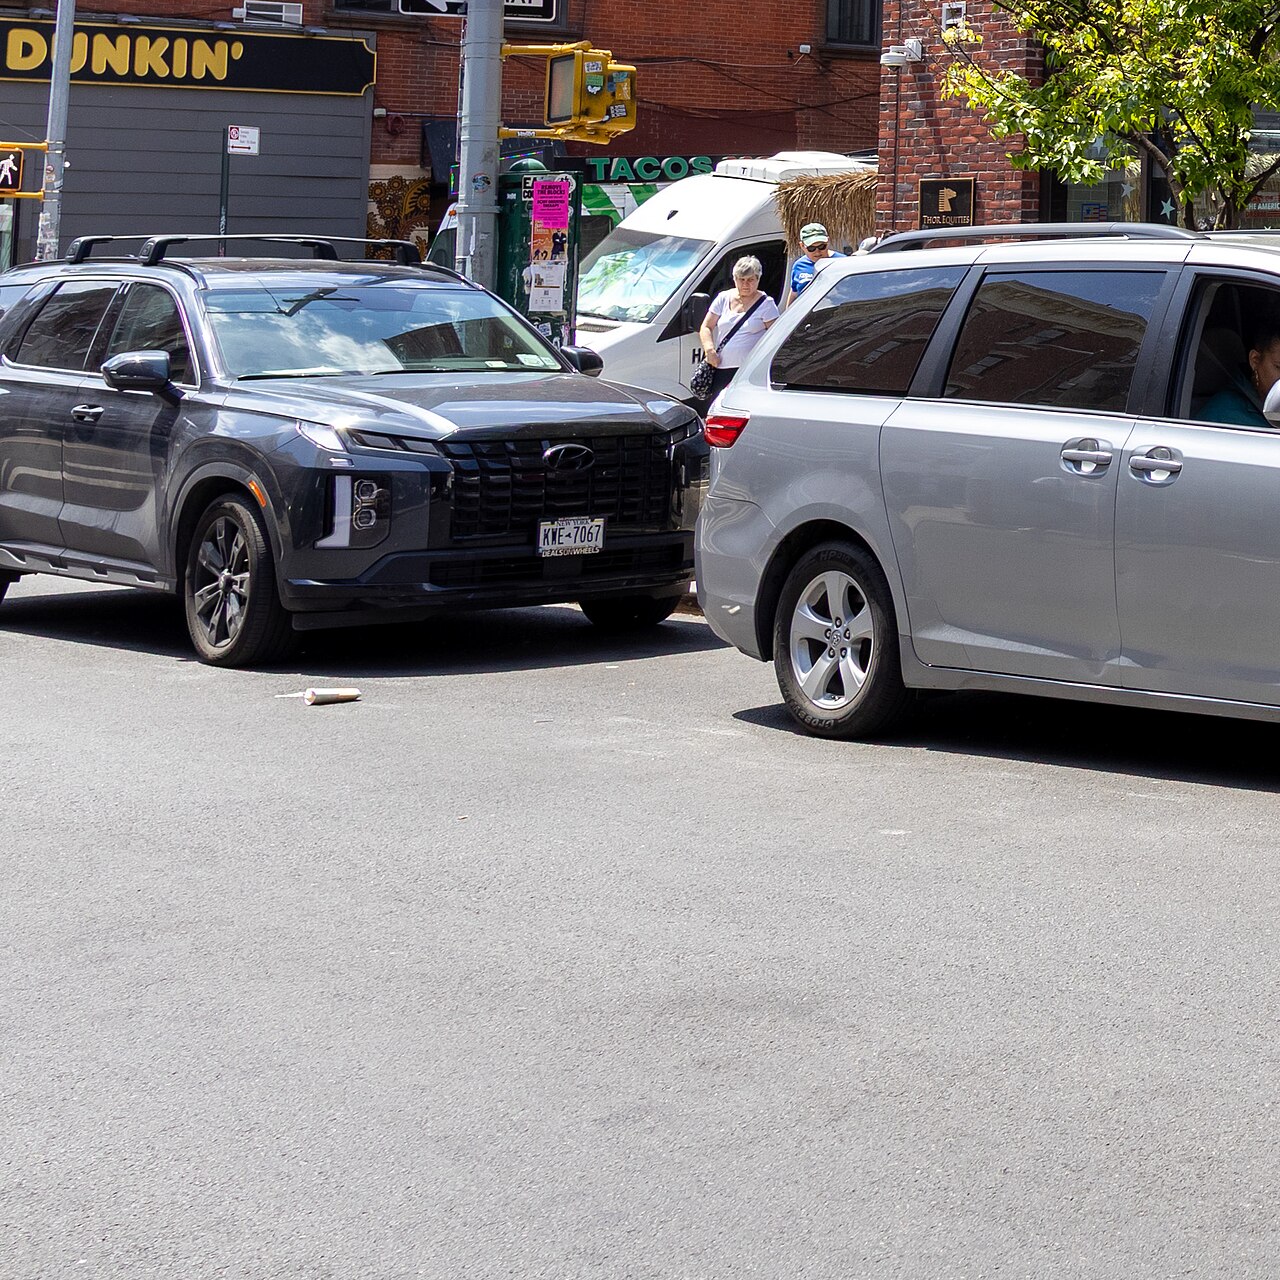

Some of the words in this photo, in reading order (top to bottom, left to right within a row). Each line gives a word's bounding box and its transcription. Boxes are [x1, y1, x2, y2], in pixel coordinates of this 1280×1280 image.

[586, 157, 715, 180] TACOS
[922, 215, 941, 224] THOR
[942, 215, 969, 225] EQUITIES
